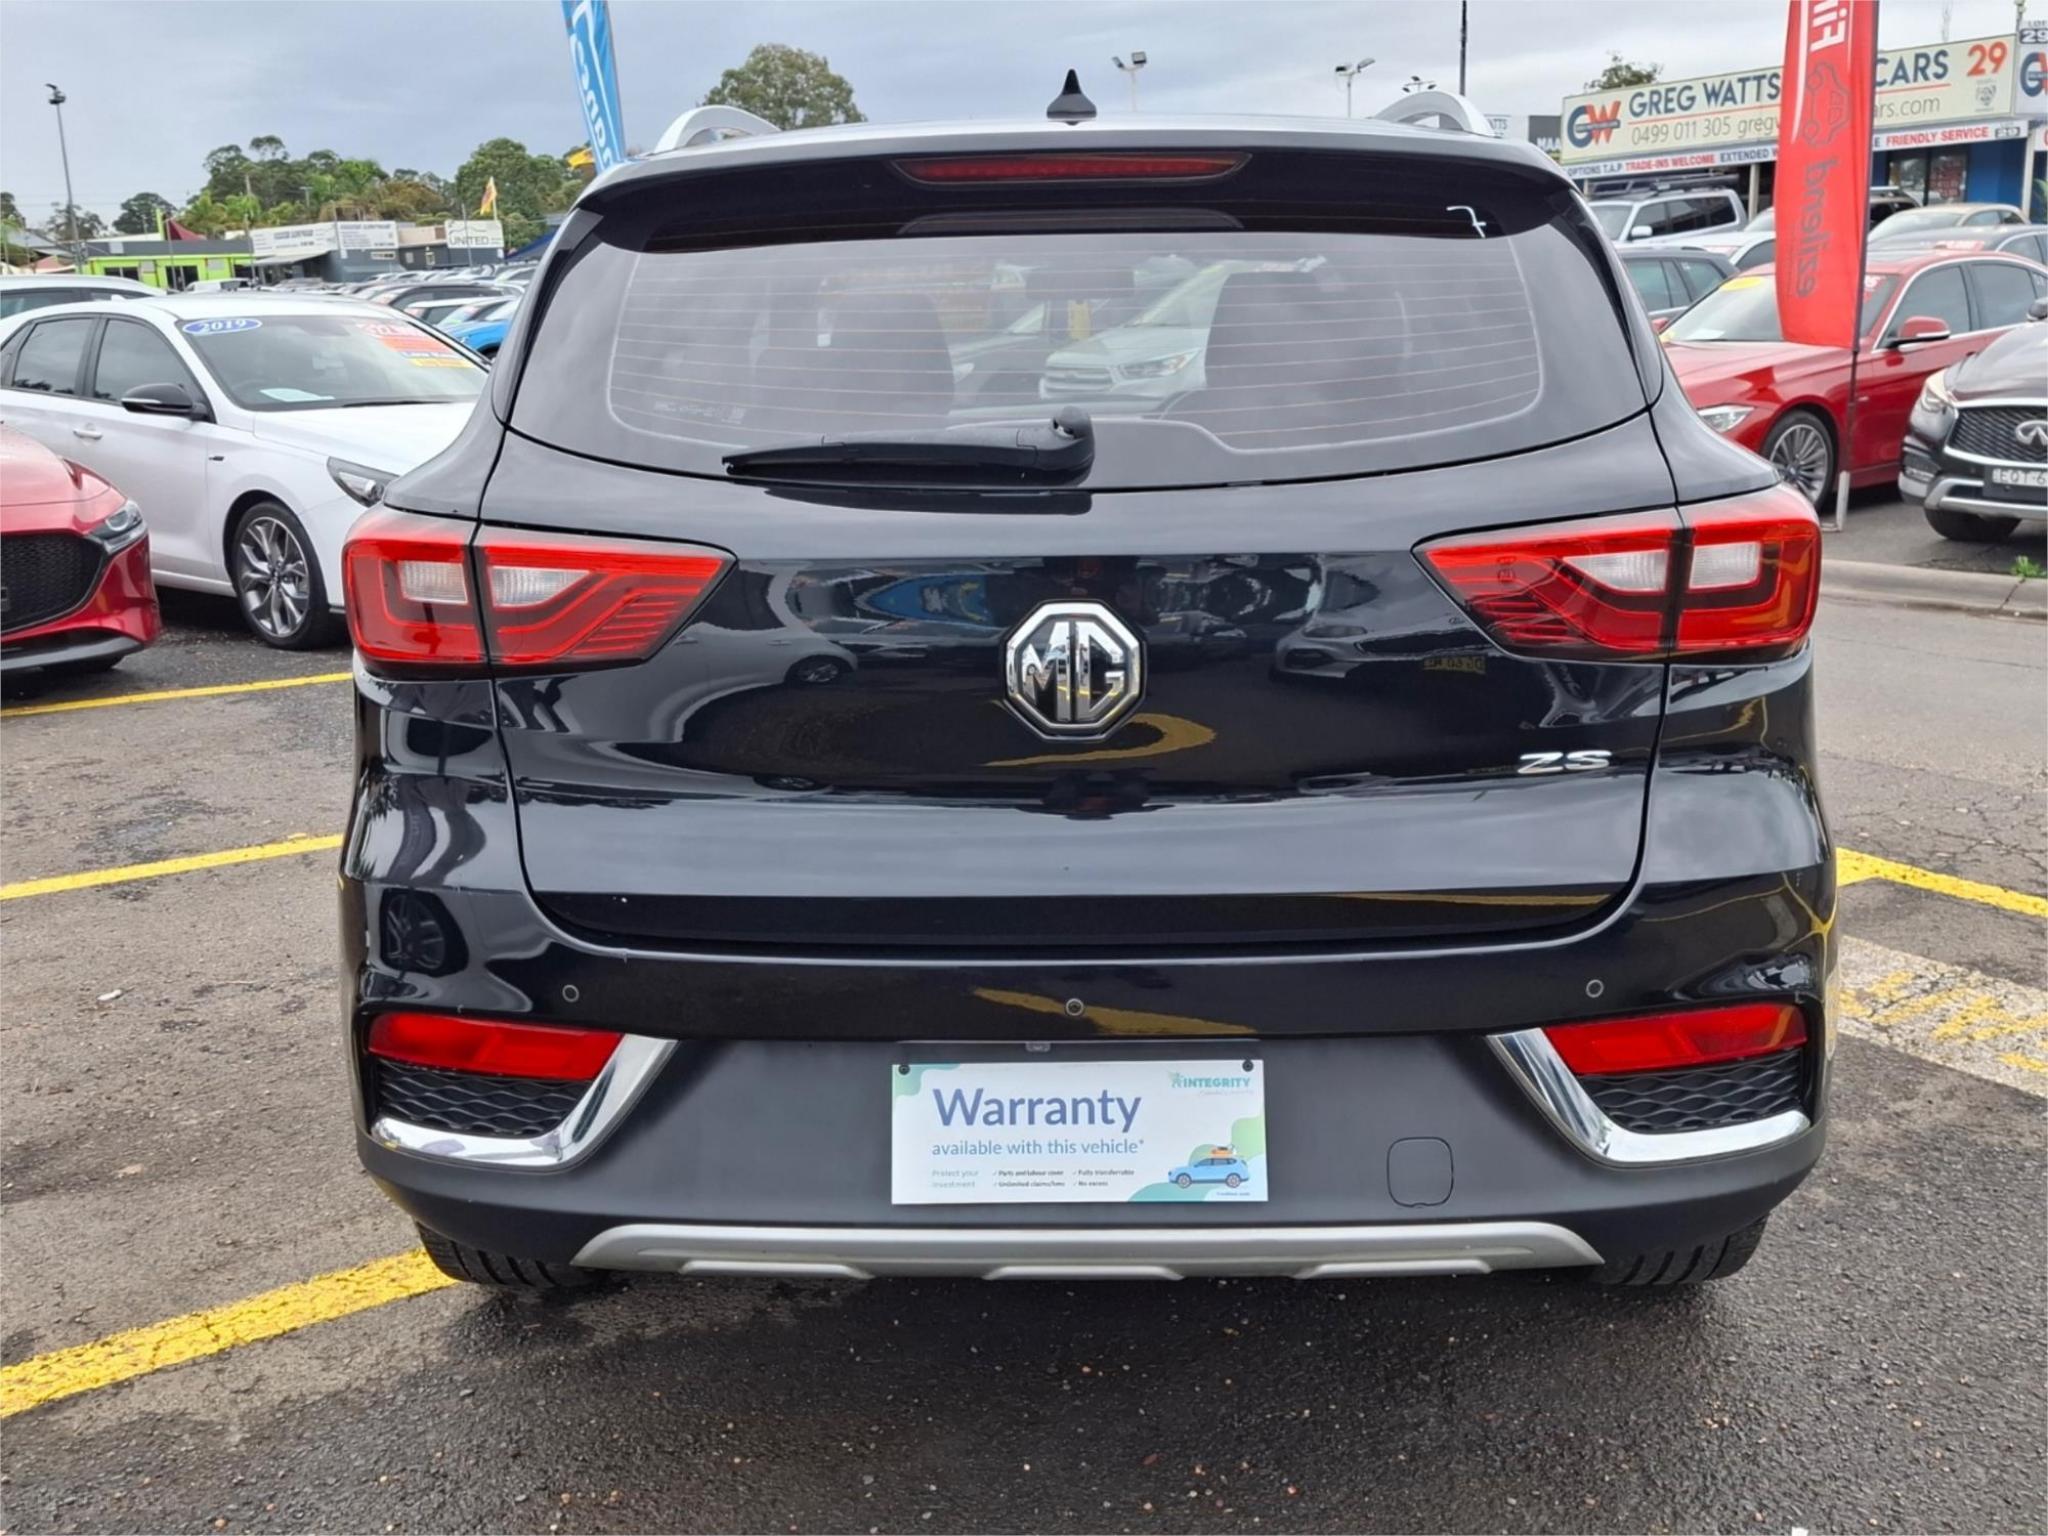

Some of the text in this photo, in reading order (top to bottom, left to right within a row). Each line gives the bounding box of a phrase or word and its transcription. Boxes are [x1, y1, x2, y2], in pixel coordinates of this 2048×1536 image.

[1629, 85, 1697, 118] GREG
[1702, 73, 1780, 108] WATTS
[1967, 41, 2008, 77] 29
[1631, 123, 1670, 146] 0499
[1674, 120, 1697, 142] 011
[1703, 116, 1731, 138] 305
[1671, 154, 1716, 167] WELCOME
[1720, 148, 1770, 163] EXTENDED
[1885, 130, 1938, 146] FRIENDLY
[1940, 126, 1990, 142] SERVICE
[449, 235, 489, 246] UNITED
[198, 318, 247, 334] 2019
[1020, 621, 1126, 724] MG
[1517, 750, 1613, 775] ZS
[1183, 1077, 1251, 1089] INTEGRITY
[931, 1087, 1141, 1133] Warranty
[932, 1139, 1002, 1156] available
[1006, 1138, 1043, 1155] with
[1048, 1138, 1077, 1155] this
